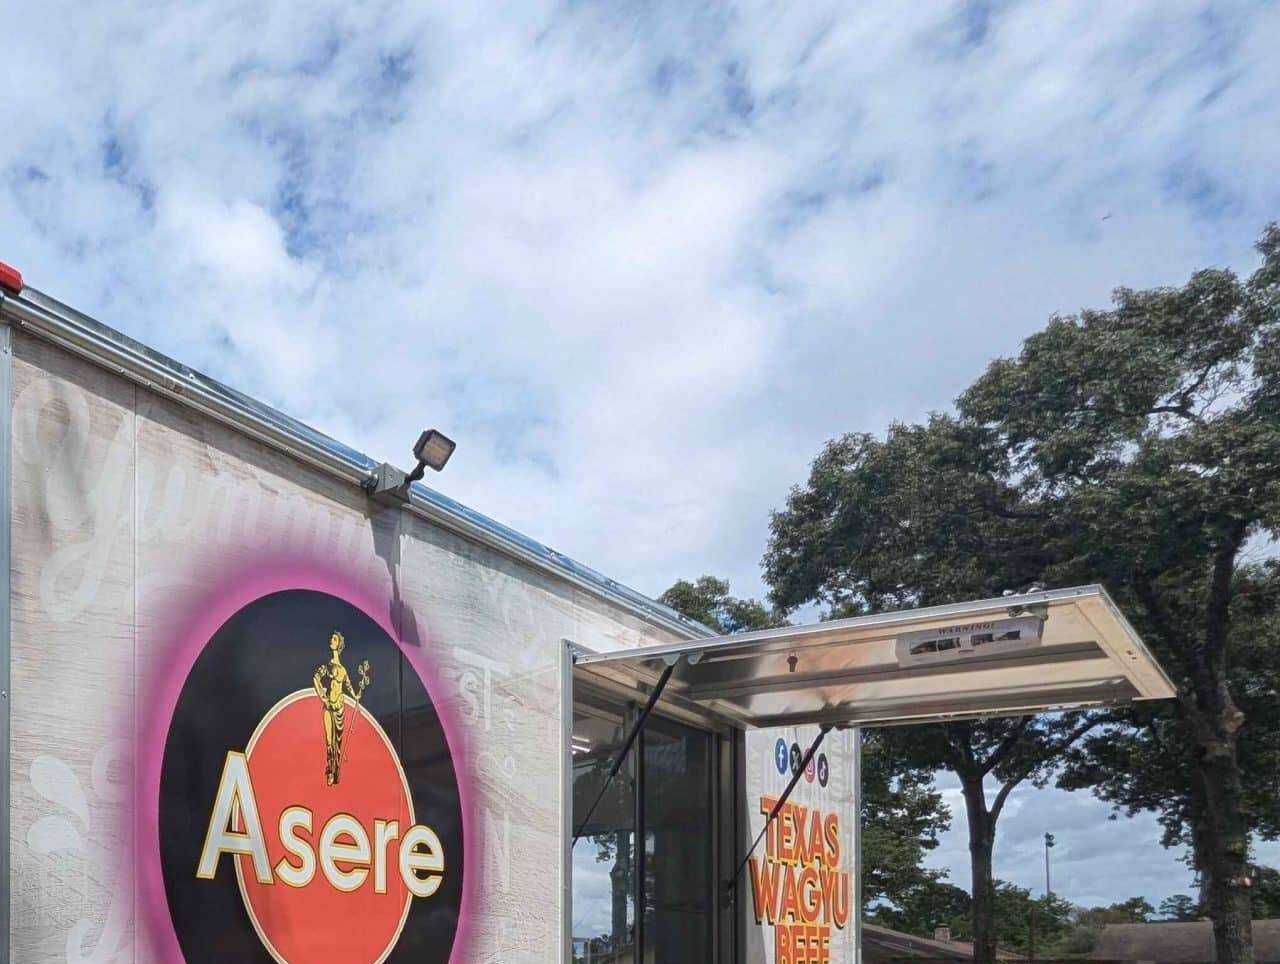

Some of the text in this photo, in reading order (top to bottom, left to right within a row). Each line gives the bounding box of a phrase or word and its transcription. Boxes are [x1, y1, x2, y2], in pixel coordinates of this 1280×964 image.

[938, 622, 994, 635] WARNING!
[196, 750, 445, 898] Asere
[760, 796, 841, 870] TEXAS
[748, 858, 850, 930] WAGYU
